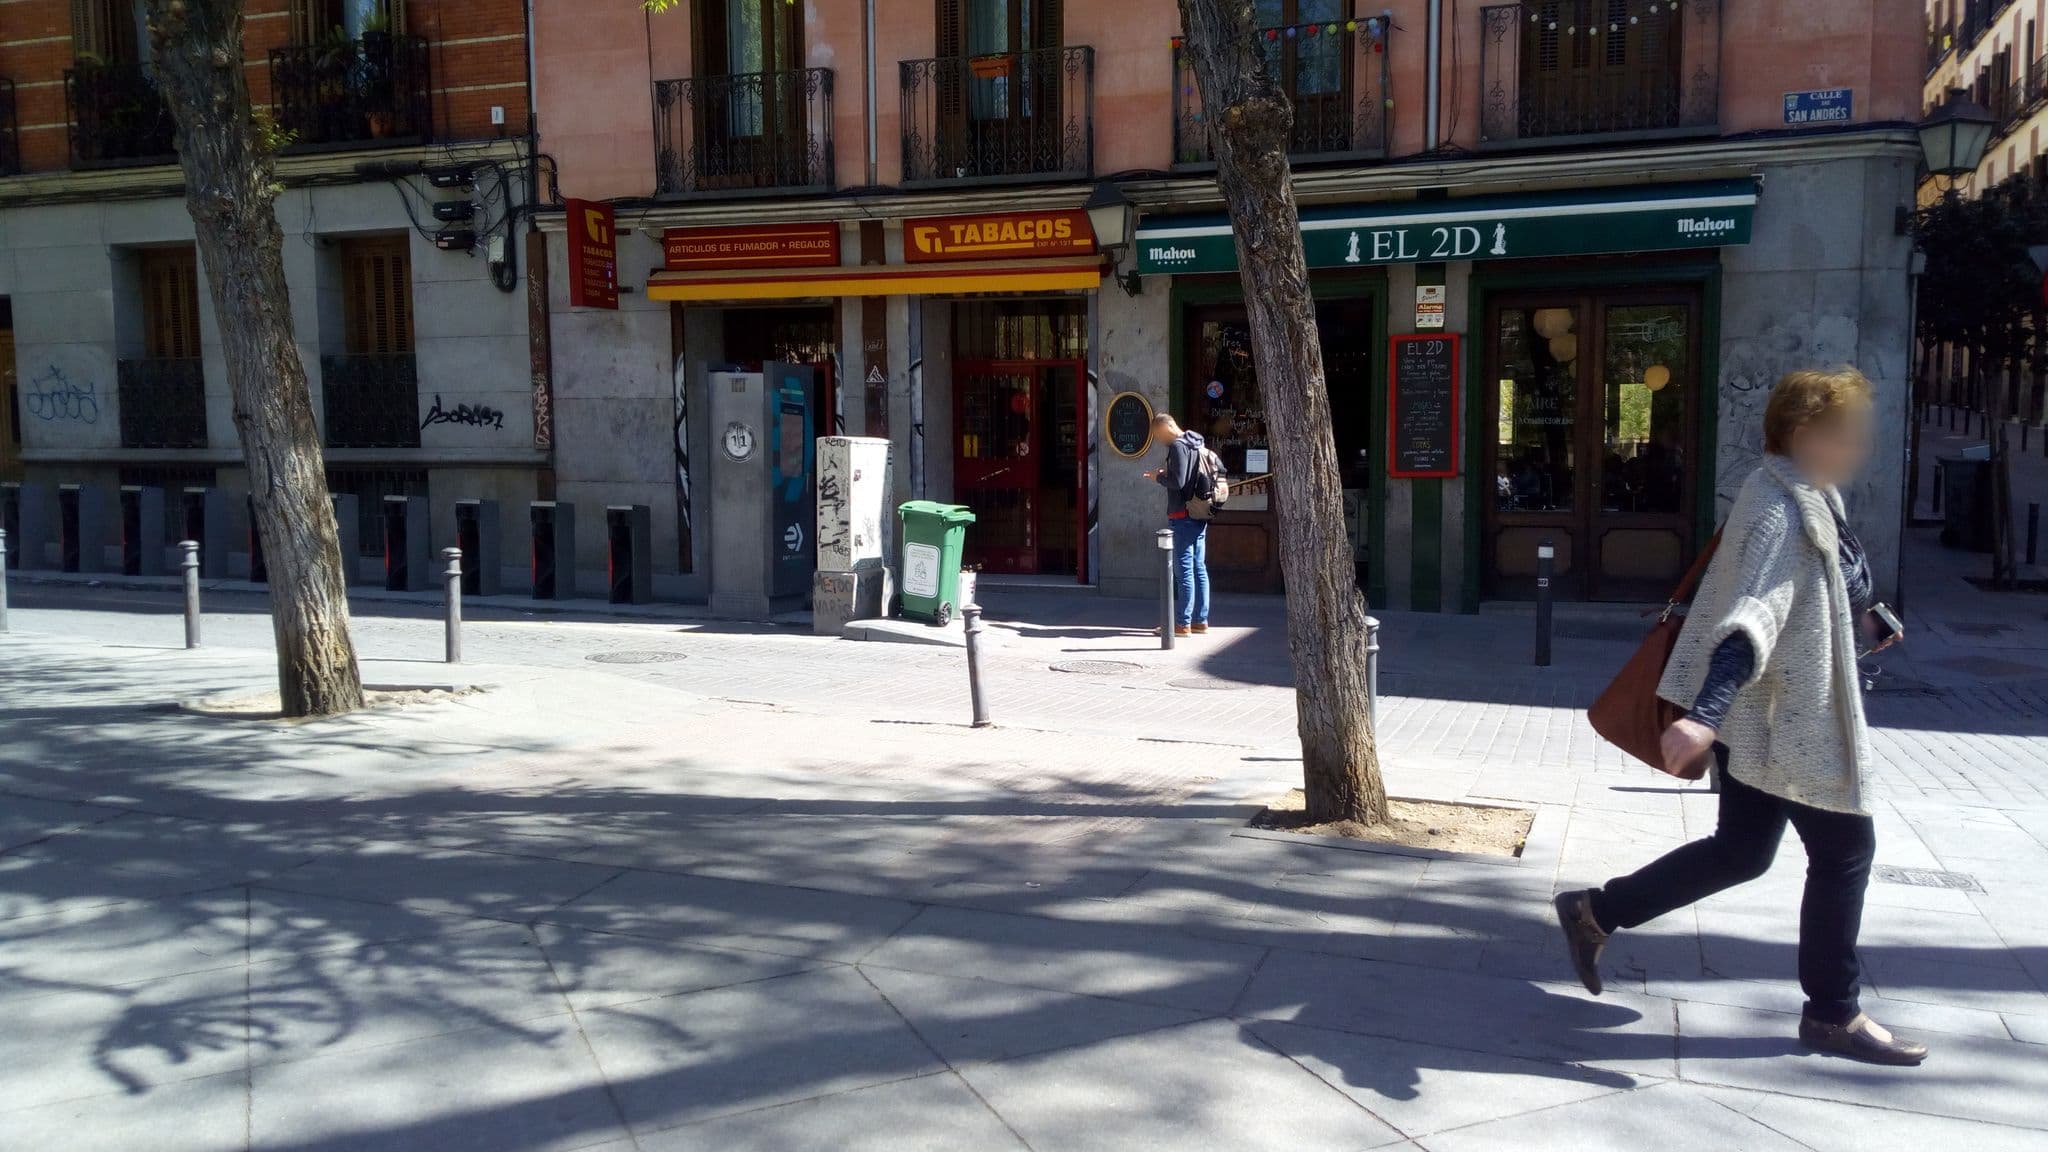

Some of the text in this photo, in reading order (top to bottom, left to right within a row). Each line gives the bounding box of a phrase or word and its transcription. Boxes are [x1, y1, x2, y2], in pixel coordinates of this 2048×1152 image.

[1810, 91, 1842, 100] CALLE
[1788, 106, 1847, 122] SAN ANDRÉS
[950, 218, 1072, 243] TABACOS
[1677, 217, 1736, 232] Mahou
[669, 240, 831, 254] ARTICULOS DE FUMADOR REGALOS
[1370, 226, 1481, 261] EL 2D
[583, 246, 613, 258] TABACOS
[1148, 246, 1197, 261] Mahou
[1407, 340, 1443, 355] EL 2D
